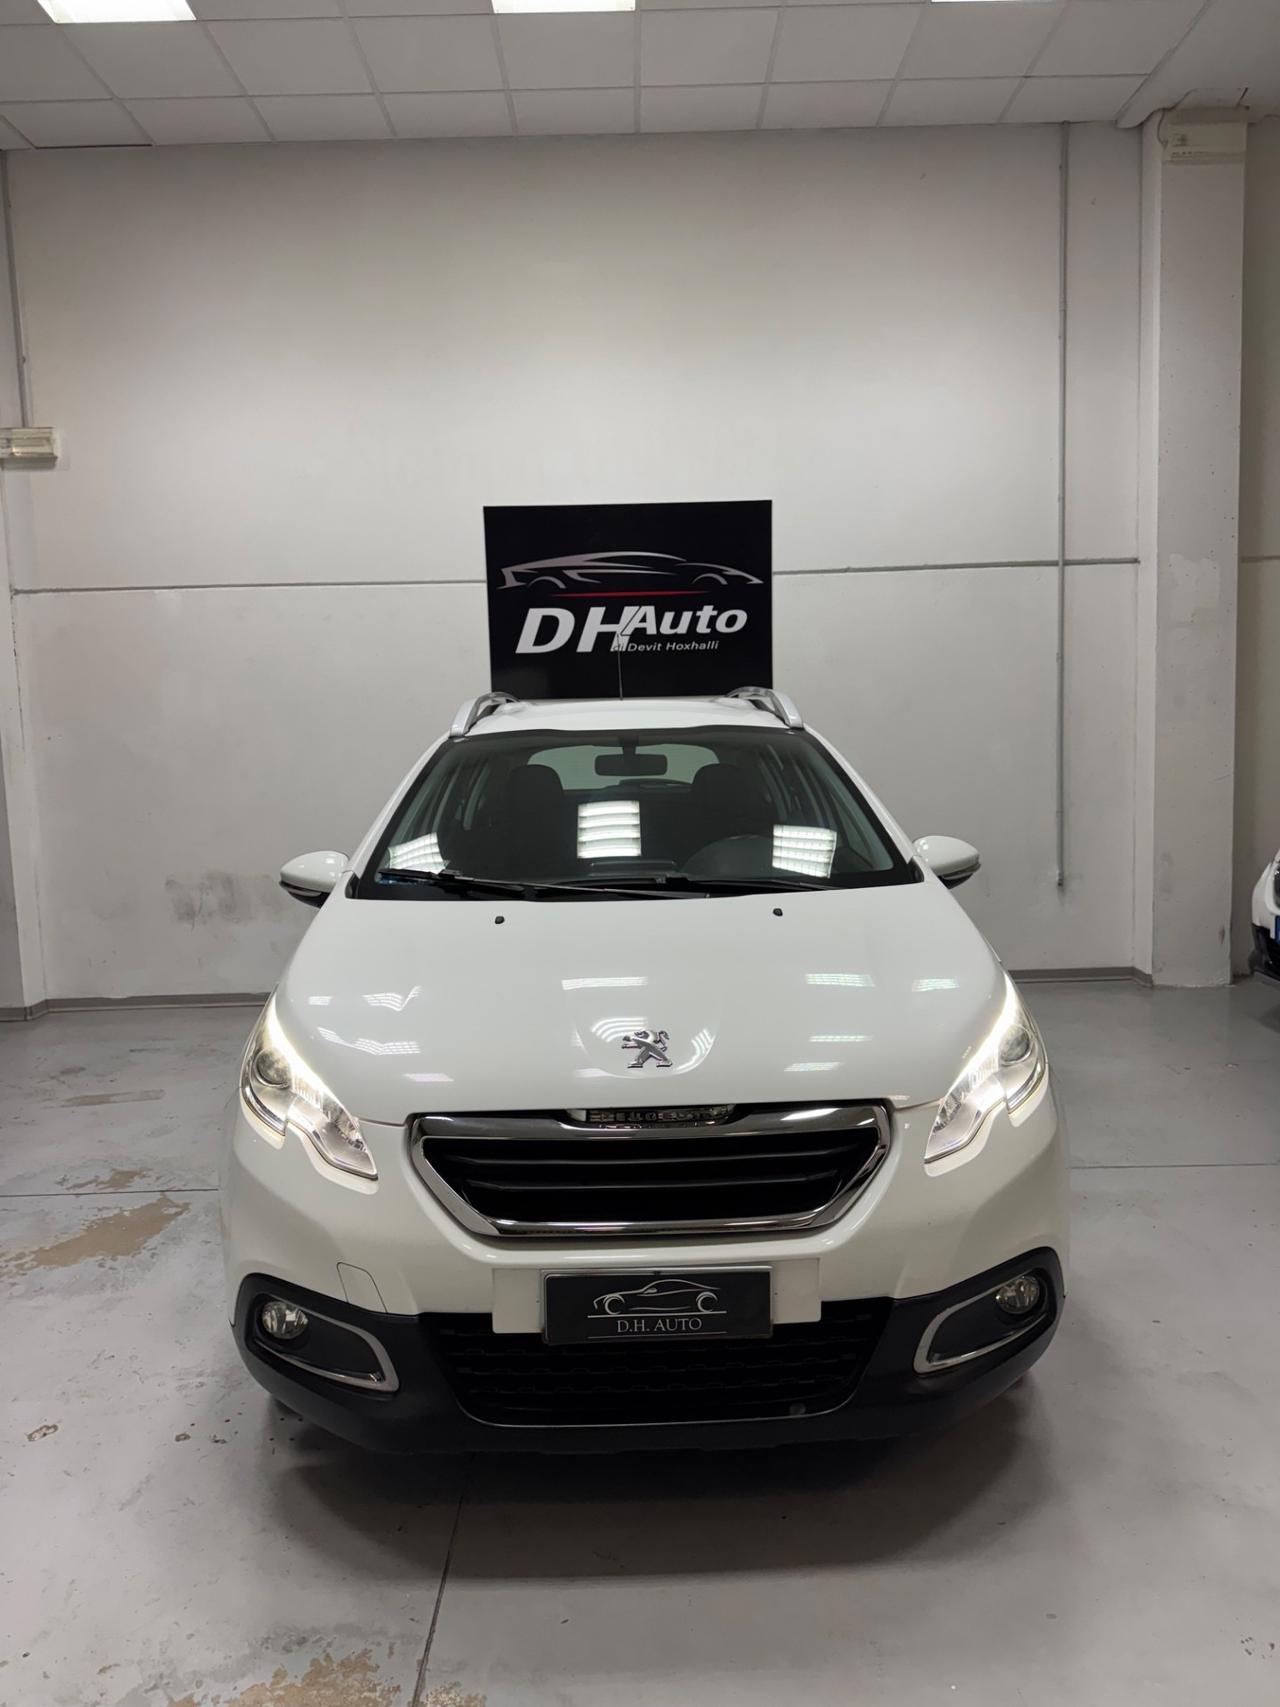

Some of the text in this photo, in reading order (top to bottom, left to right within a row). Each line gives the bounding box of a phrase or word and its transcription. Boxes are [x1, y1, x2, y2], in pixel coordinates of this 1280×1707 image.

[627, 642, 662, 652] Devit
[665, 640, 720, 651] Hoxhalli
[617, 1318, 702, 1333] D.H. AUTO
